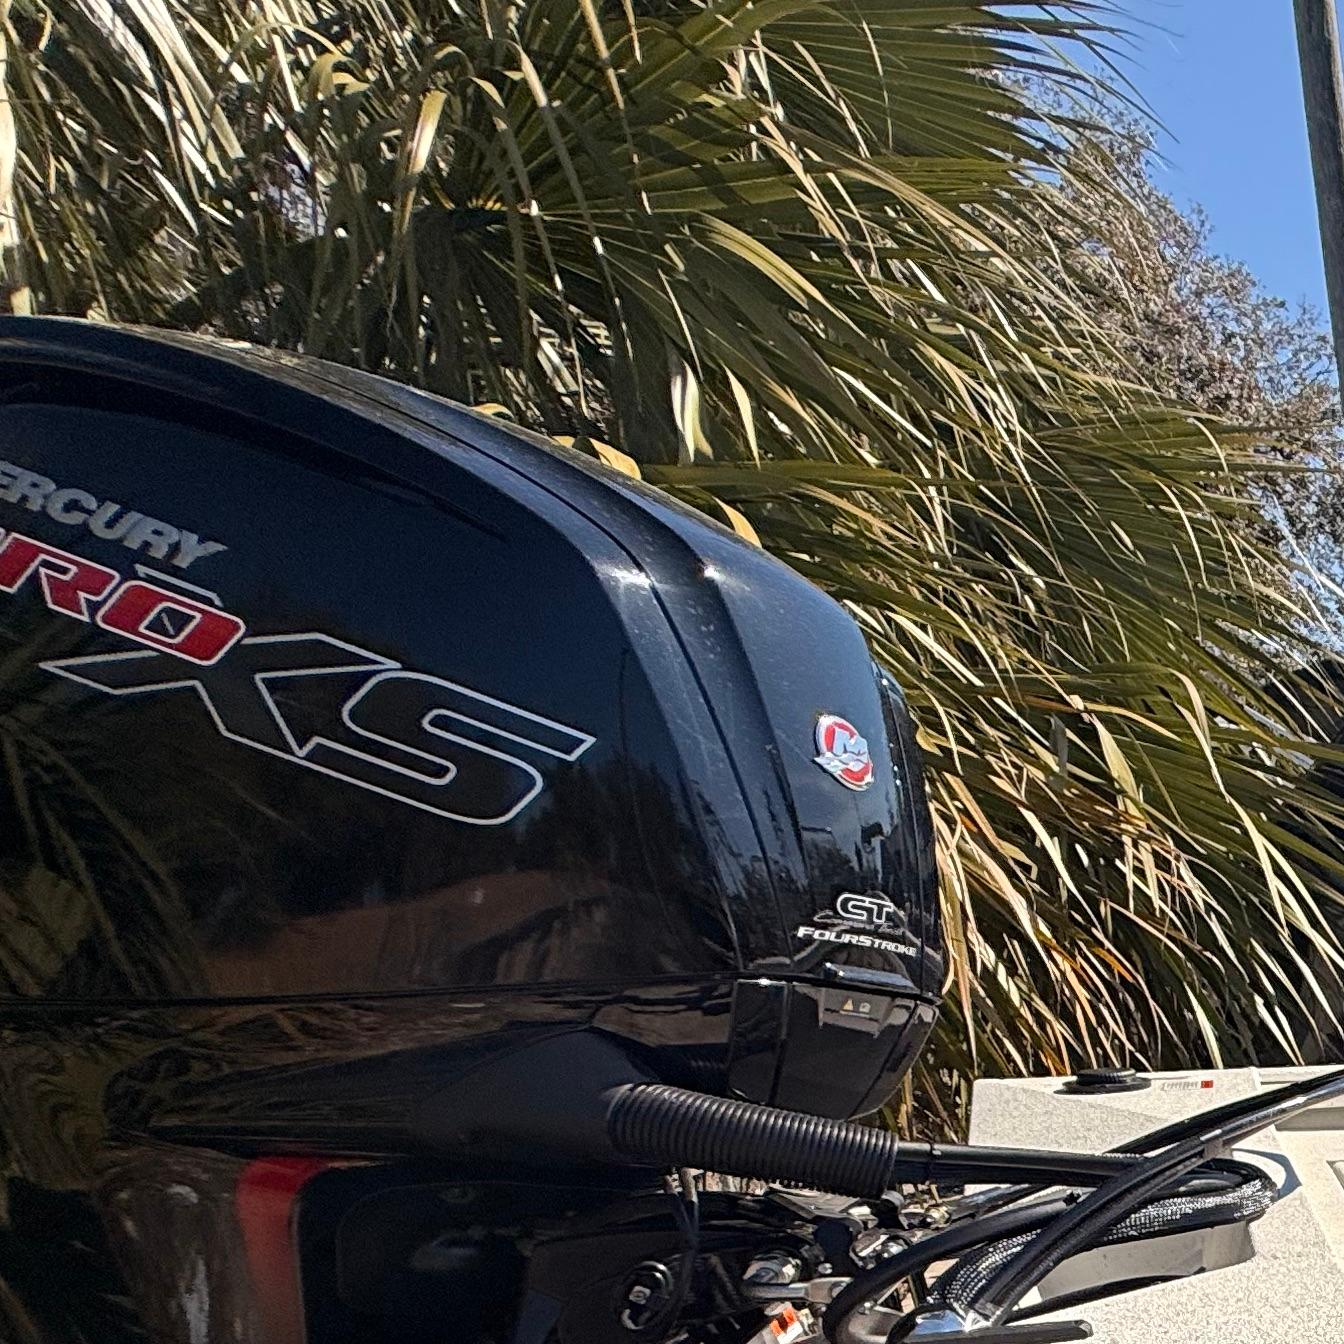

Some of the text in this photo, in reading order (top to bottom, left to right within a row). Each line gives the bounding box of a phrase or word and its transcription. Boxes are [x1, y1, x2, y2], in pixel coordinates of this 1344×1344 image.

[0, 460, 228, 569] ERCURY
[0, 527, 597, 825] RO XS
